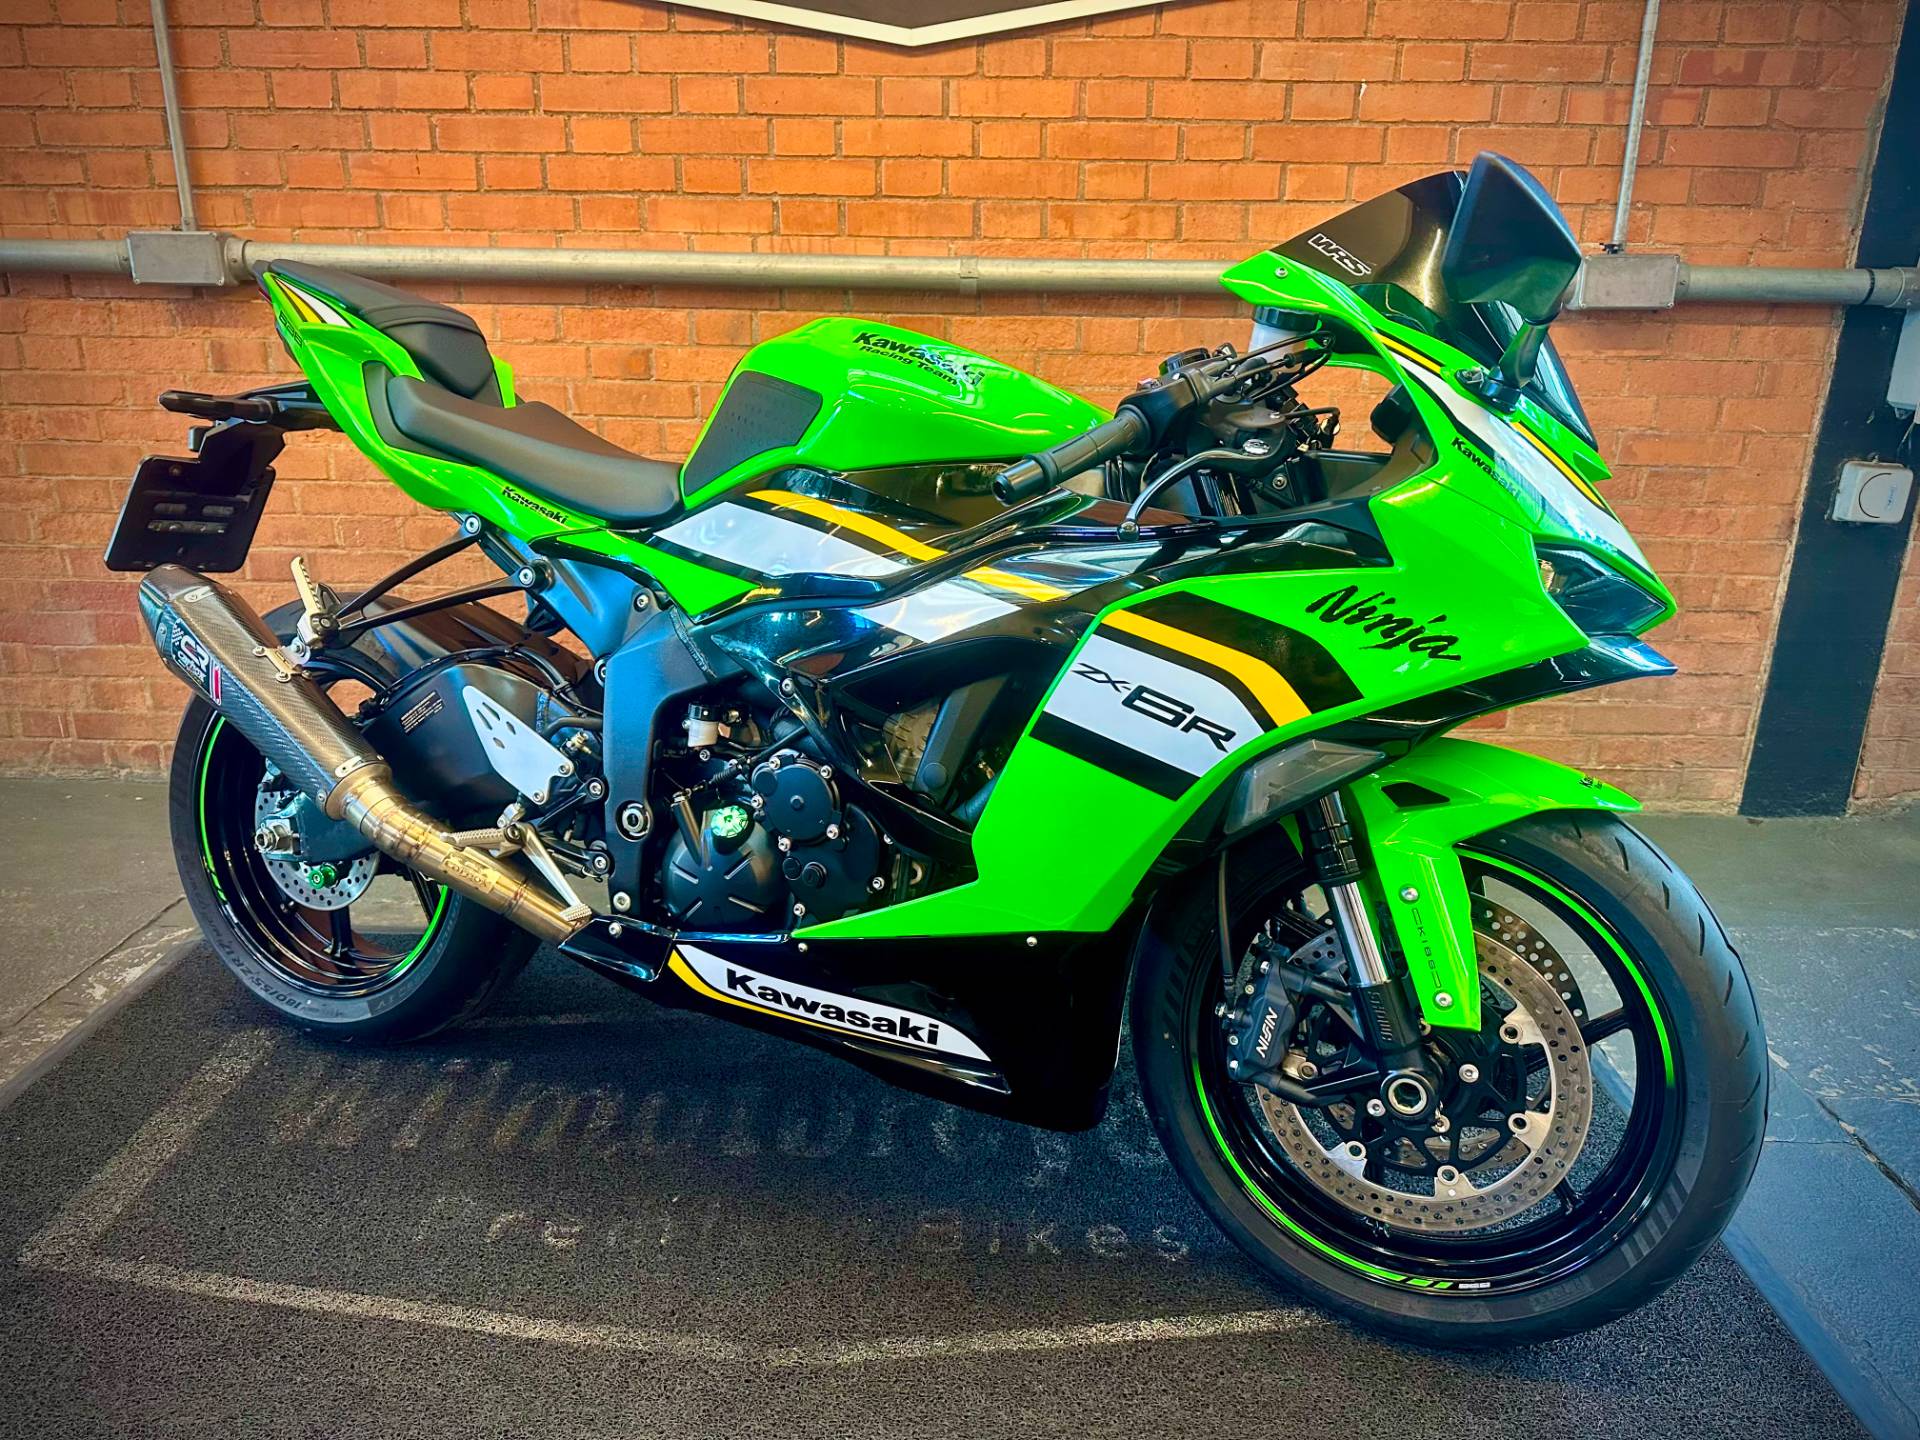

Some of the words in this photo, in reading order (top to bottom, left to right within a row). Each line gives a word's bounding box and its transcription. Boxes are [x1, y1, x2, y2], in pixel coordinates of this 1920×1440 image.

[1307, 232, 1372, 276] WRS
[852, 332, 986, 386] Kawasaki
[859, 345, 913, 365] Racing
[917, 361, 958, 386] Team
[1451, 437, 1521, 501] Kawasaki
[502, 485, 569, 525] Kawasaki
[1305, 585, 1462, 661] Ninja
[726, 967, 940, 1046] Kawasaki
